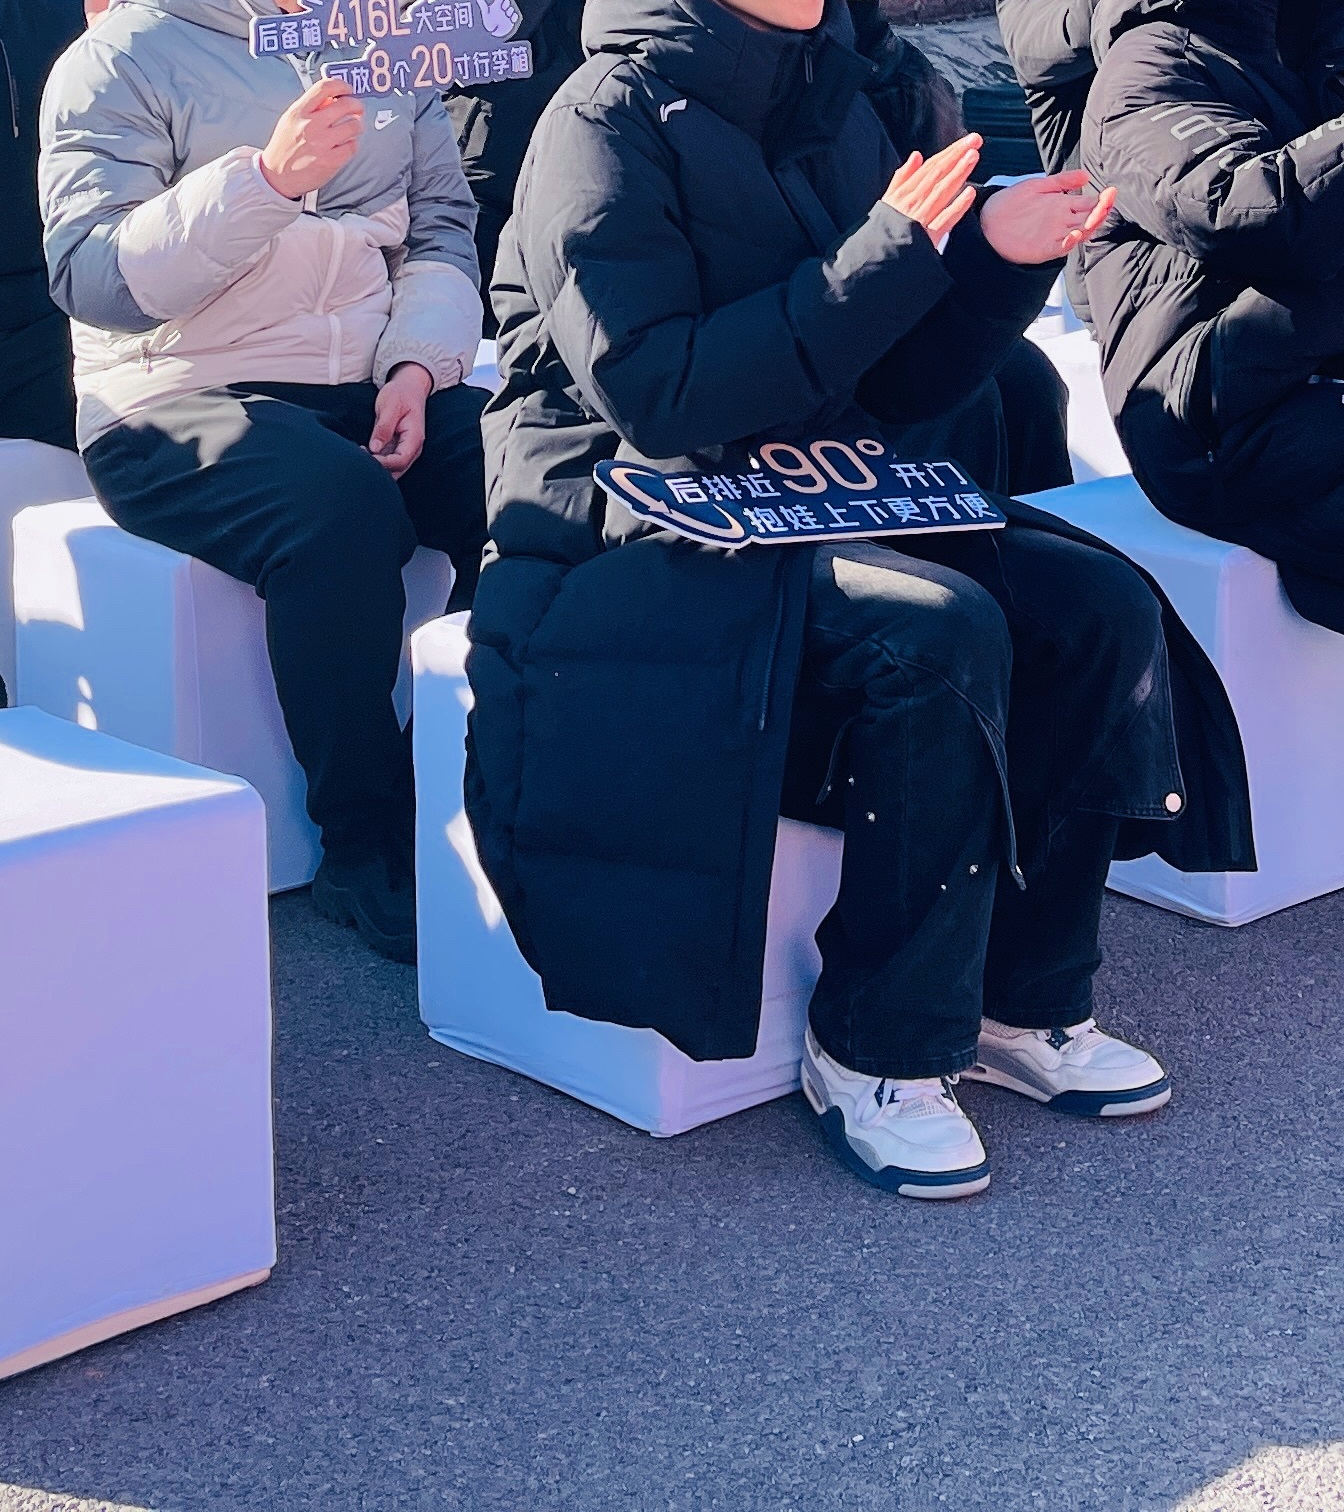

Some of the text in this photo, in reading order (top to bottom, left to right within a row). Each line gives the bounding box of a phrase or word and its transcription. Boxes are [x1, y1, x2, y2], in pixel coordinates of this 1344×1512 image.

[743, 492, 997, 534] 抱娃上下更方便
